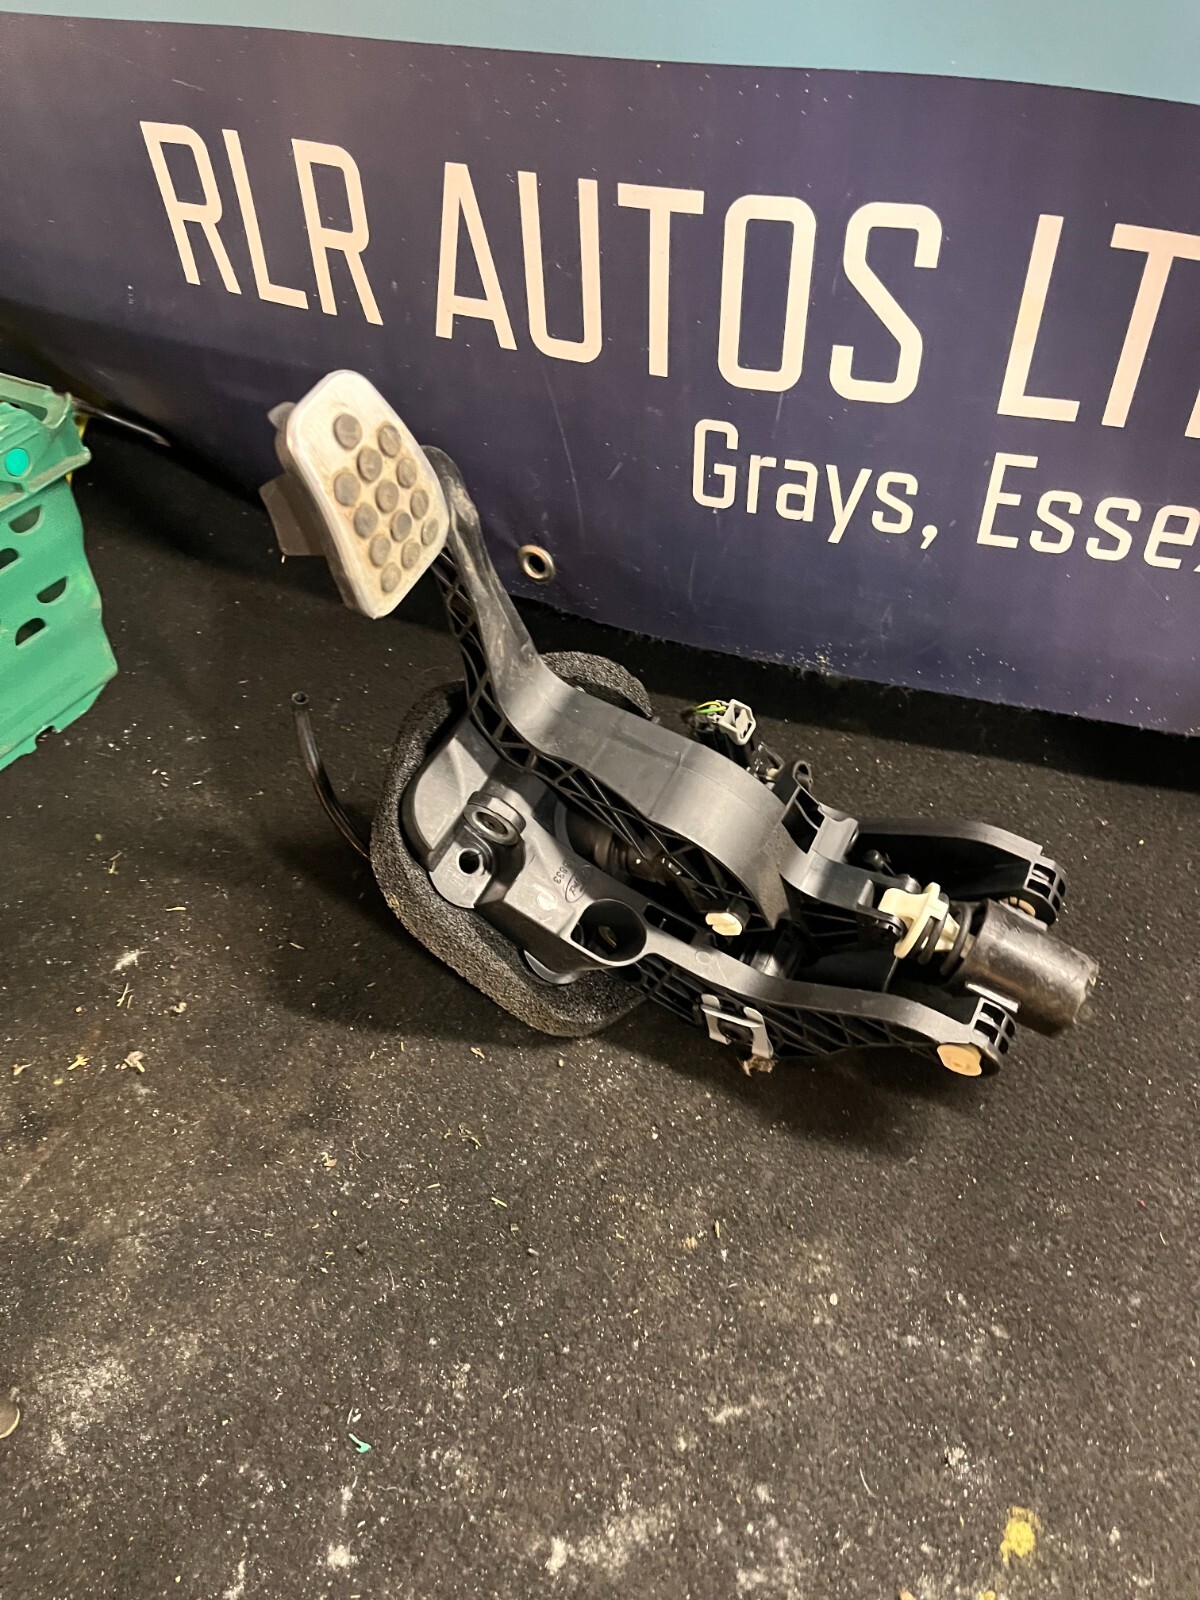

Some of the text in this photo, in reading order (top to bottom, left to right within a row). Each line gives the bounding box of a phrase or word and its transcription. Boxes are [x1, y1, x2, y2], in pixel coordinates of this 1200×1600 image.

[139, 120, 1200, 439] RLR AUTOS LT
[691, 418, 1200, 572] Grays, Esse
